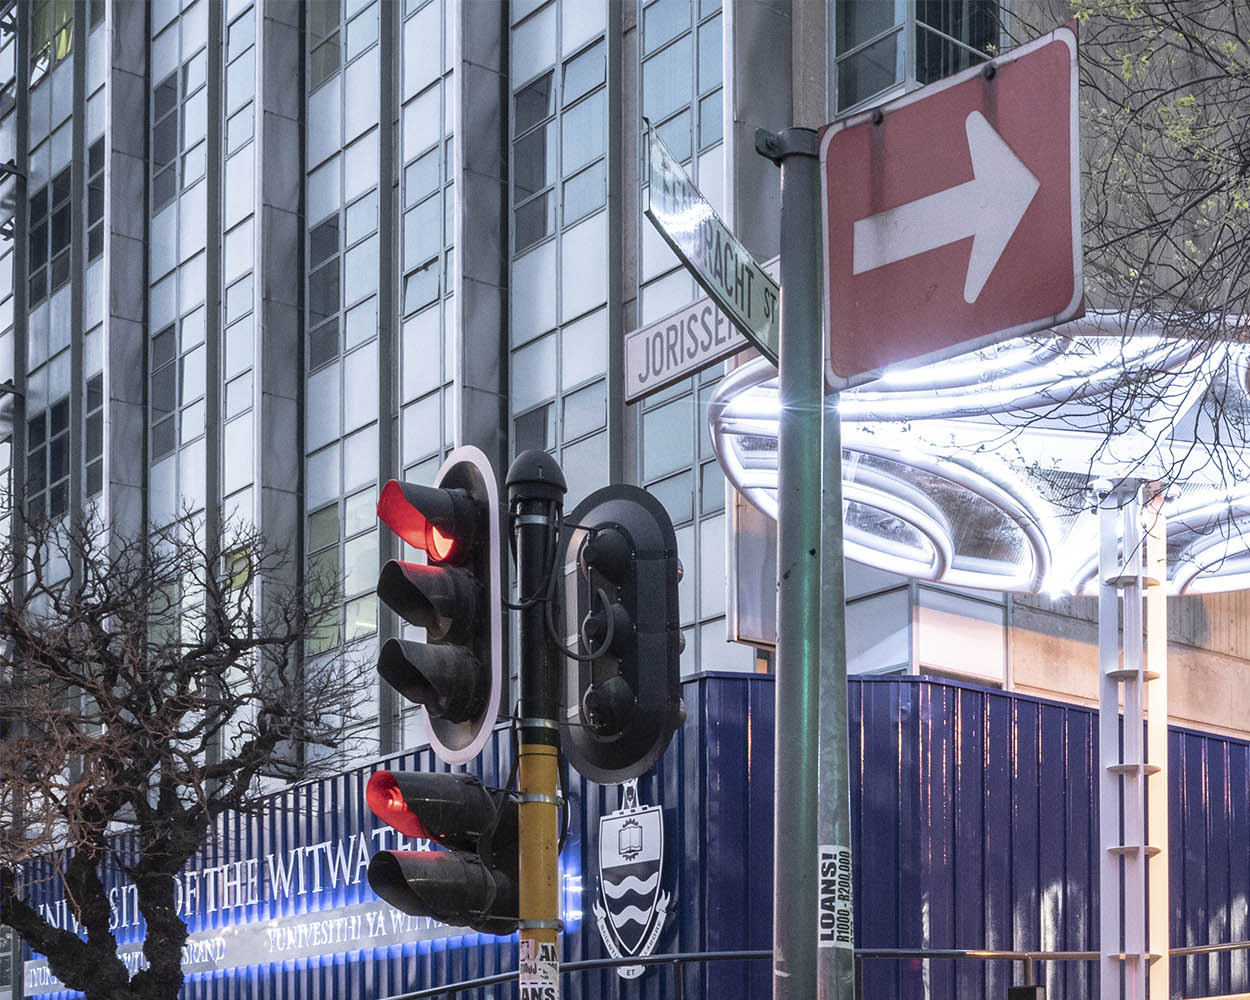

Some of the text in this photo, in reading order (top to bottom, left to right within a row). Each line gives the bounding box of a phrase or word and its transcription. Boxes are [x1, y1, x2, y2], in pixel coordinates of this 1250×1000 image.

[763, 287, 777, 324] ST
[203, 858, 259, 913] THE
[820, 853, 837, 941] LOANS!
[365, 910, 388, 938] YA
